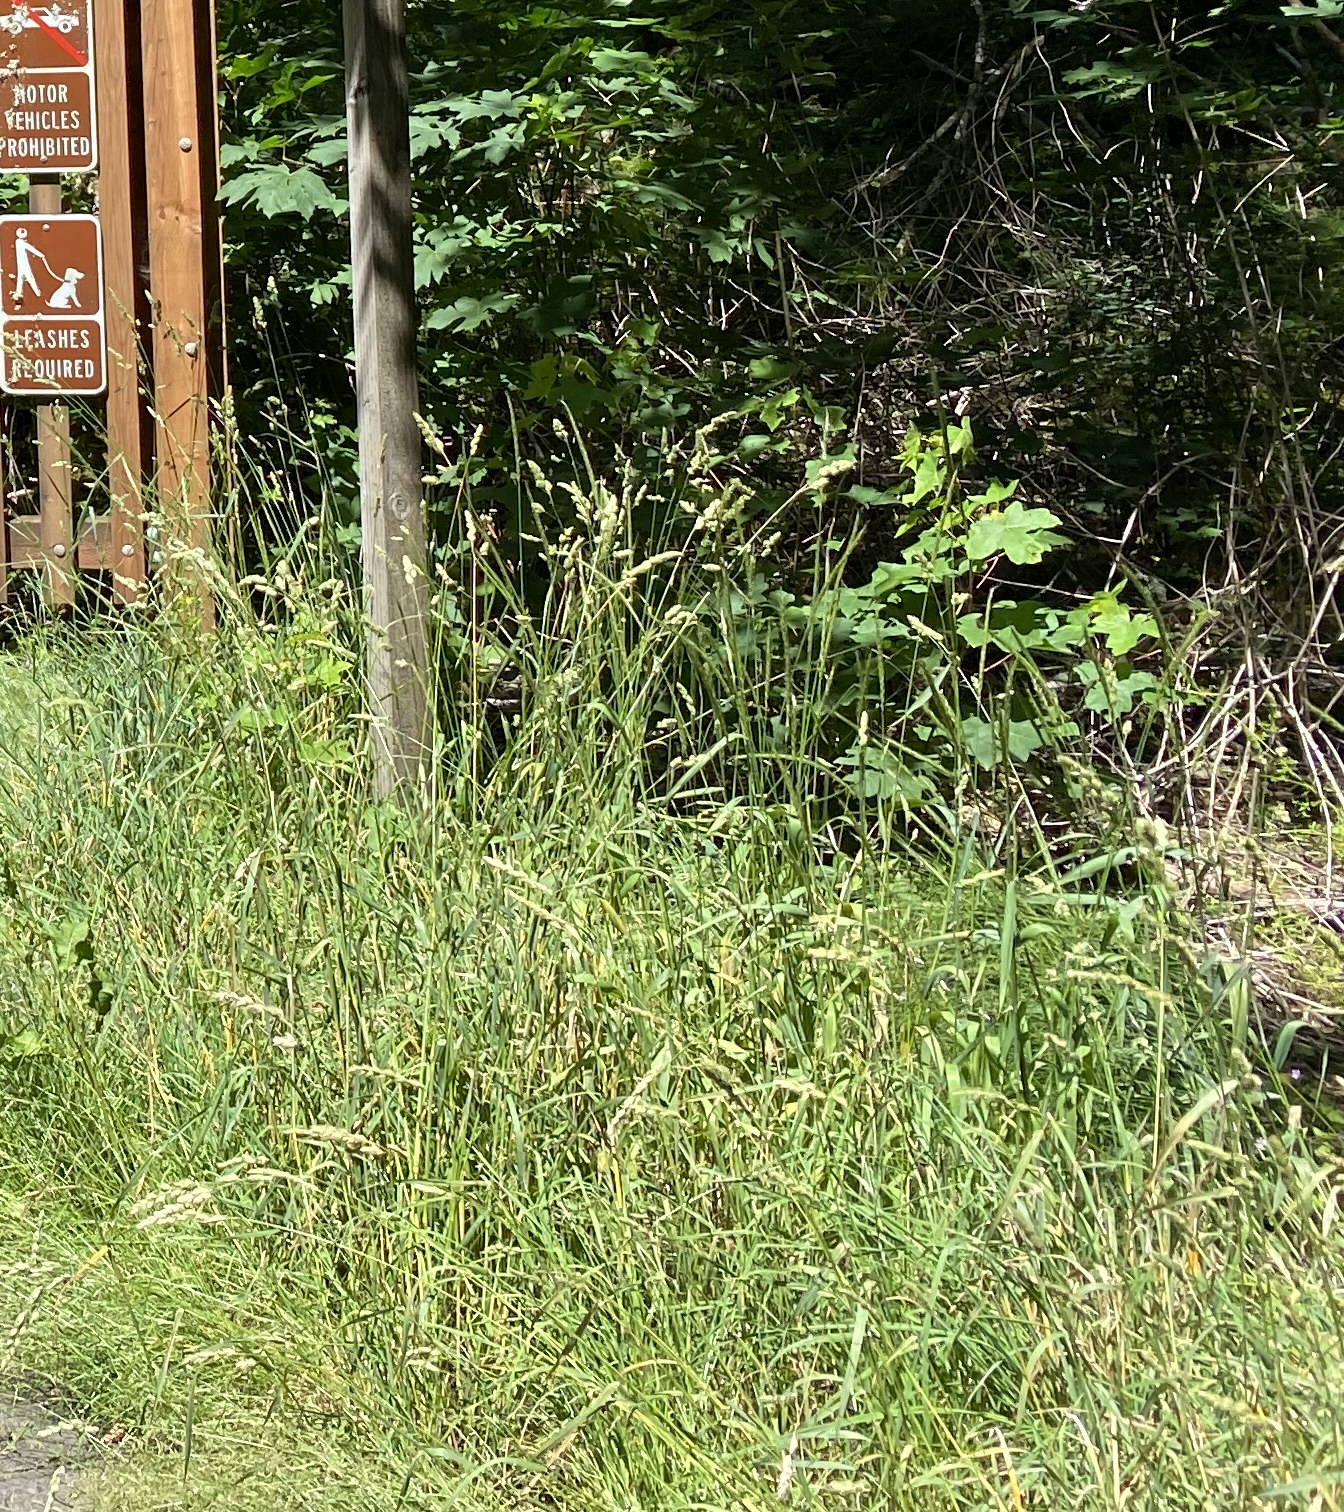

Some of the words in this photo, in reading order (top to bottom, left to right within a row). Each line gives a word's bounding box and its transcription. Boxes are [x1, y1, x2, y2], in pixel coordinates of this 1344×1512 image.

[14, 84, 68, 104] MOTOR
[5, 109, 80, 130] VEHICLES
[14, 329, 90, 350] LEASHES
[12, 357, 94, 380] REQUIRED
